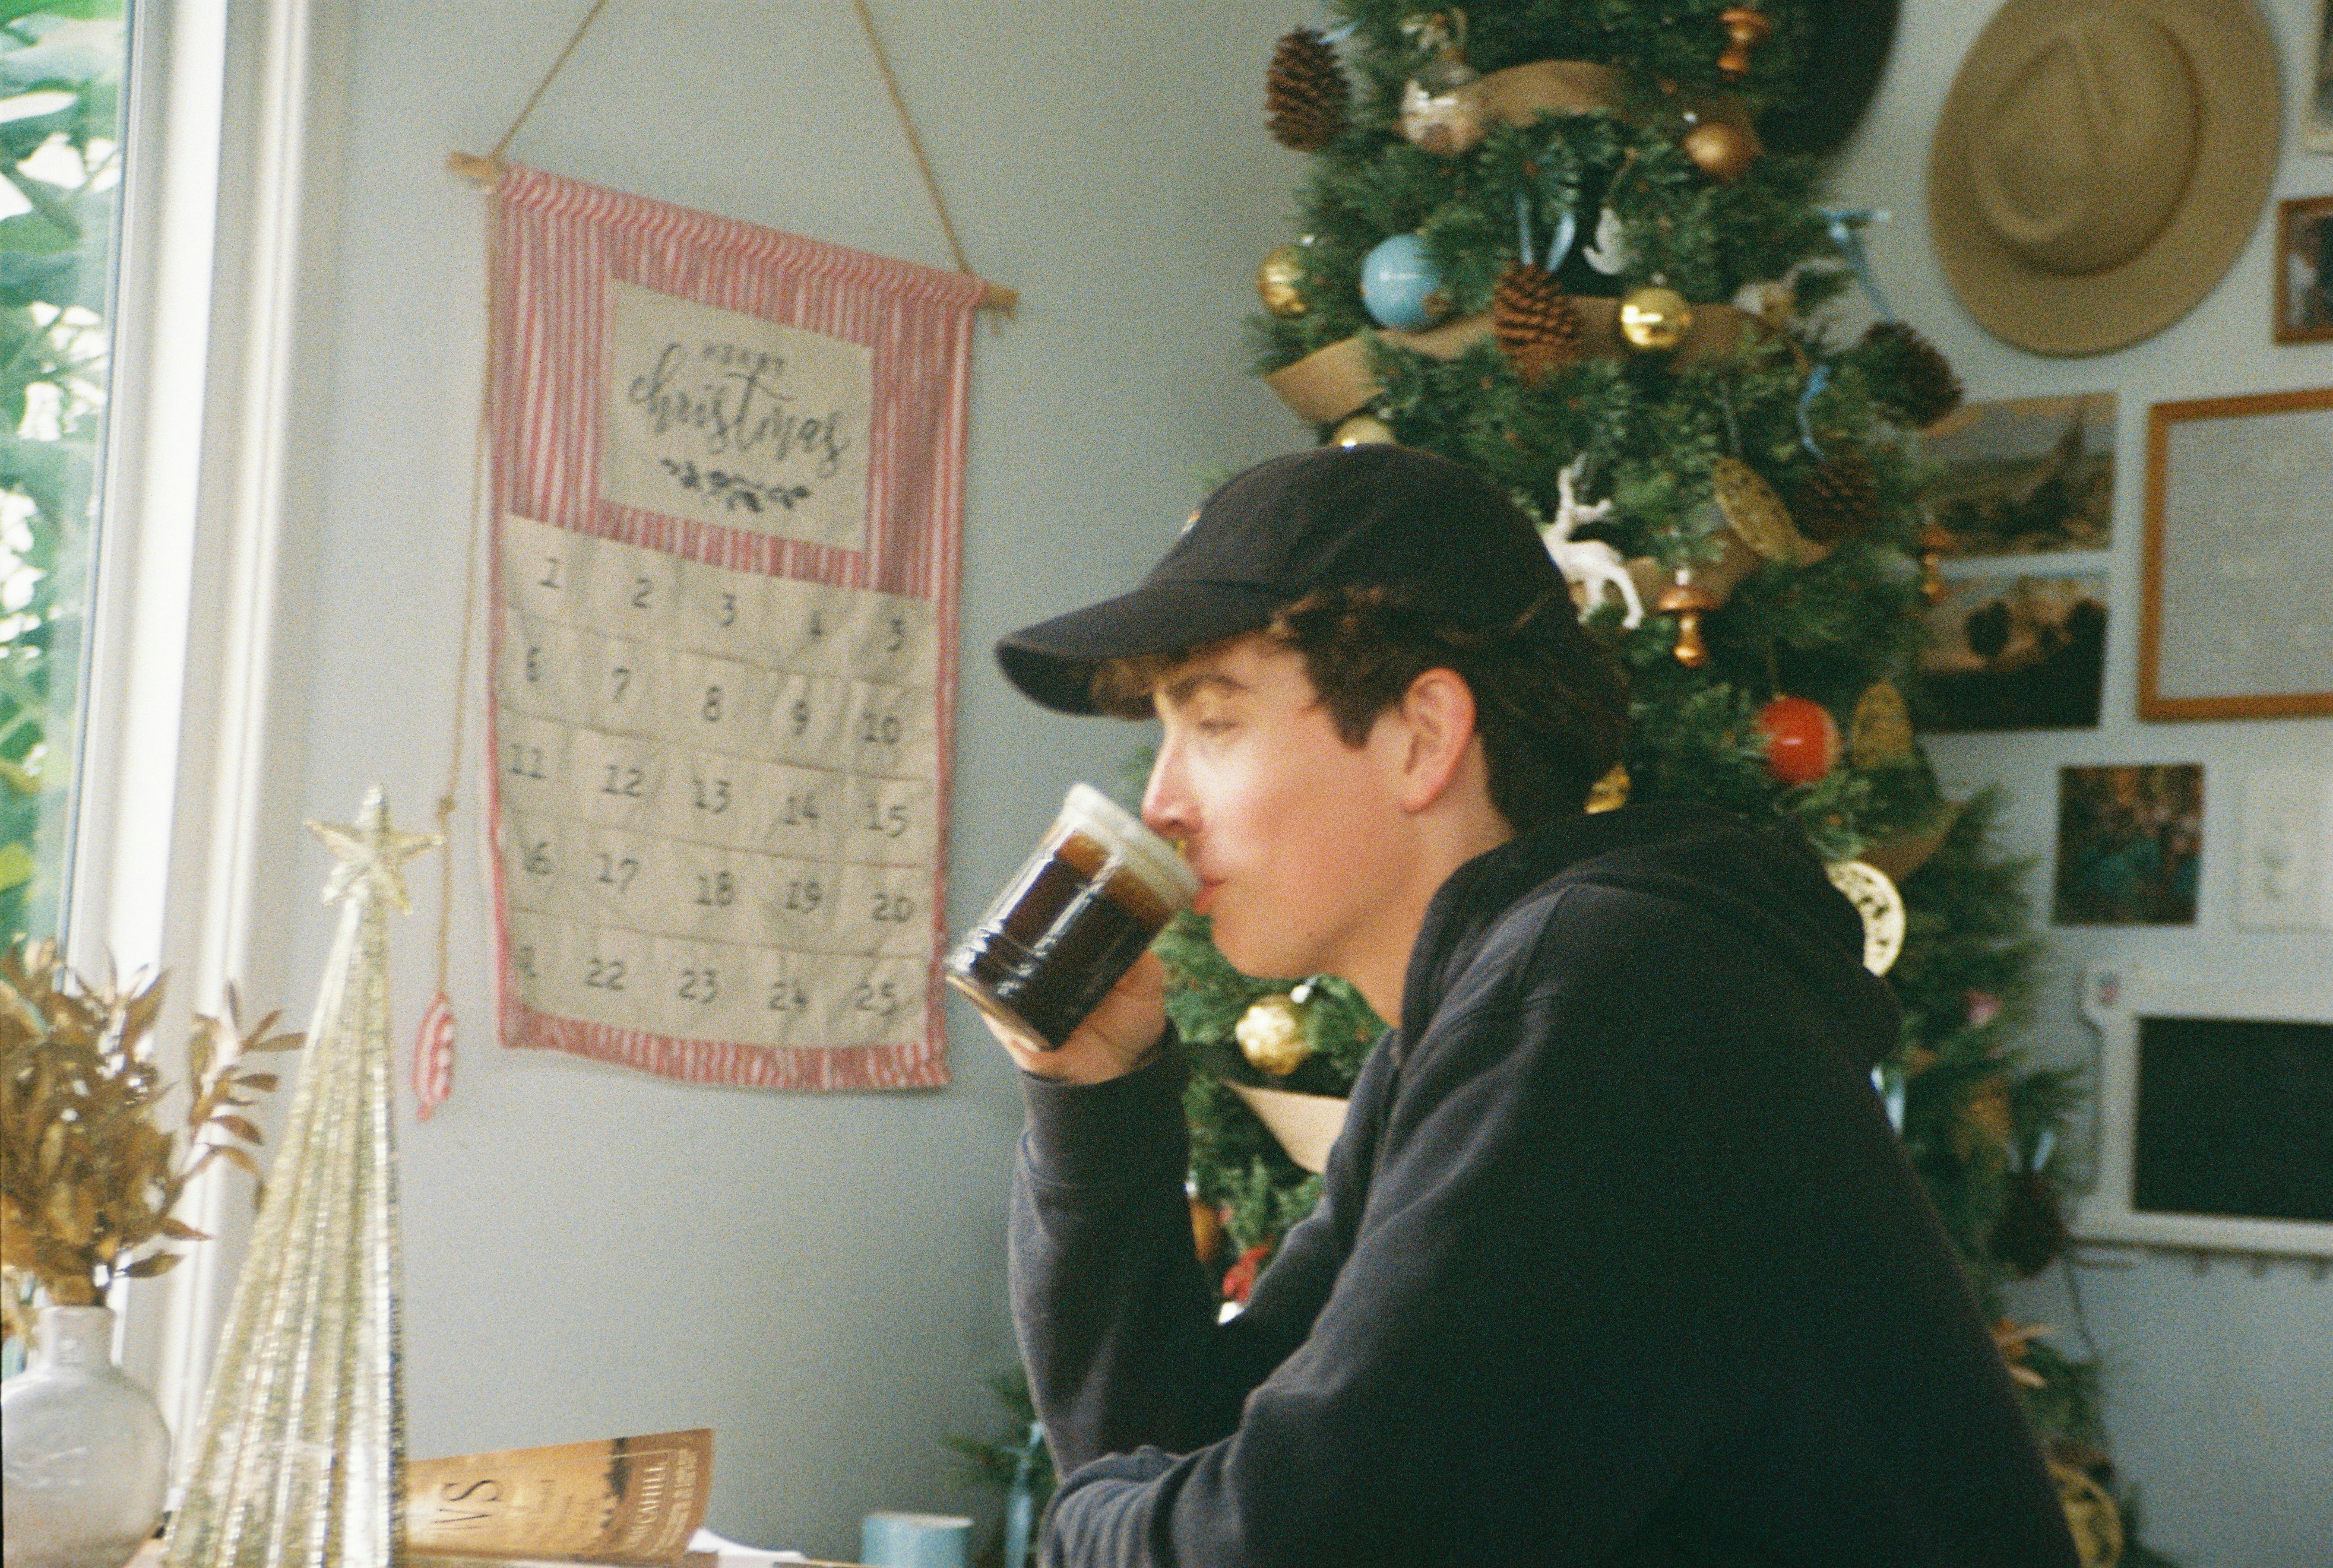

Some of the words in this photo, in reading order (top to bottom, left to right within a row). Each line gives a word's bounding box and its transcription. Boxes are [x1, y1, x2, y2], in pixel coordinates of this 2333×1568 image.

[539, 557, 560, 589] 1
[632, 577, 654, 609] 2
[719, 592, 736, 627] 3
[613, 666, 630, 701] 7
[702, 685, 723, 723] 8
[792, 699, 810, 736] 9
[861, 710, 901, 746] 10
[507, 743, 547, 779] 11
[601, 764, 643, 798] 12
[693, 779, 731, 814] 13
[784, 792, 820, 828] 14
[867, 800, 908, 839] 15
[596, 852, 639, 893] 17
[696, 871, 734, 907] 18
[785, 880, 822, 915] 19
[872, 891, 914, 923] 20
[584, 957, 626, 991] 22
[679, 968, 718, 1004] 23
[768, 980, 810, 1013] 24
[856, 980, 897, 1017] 25
